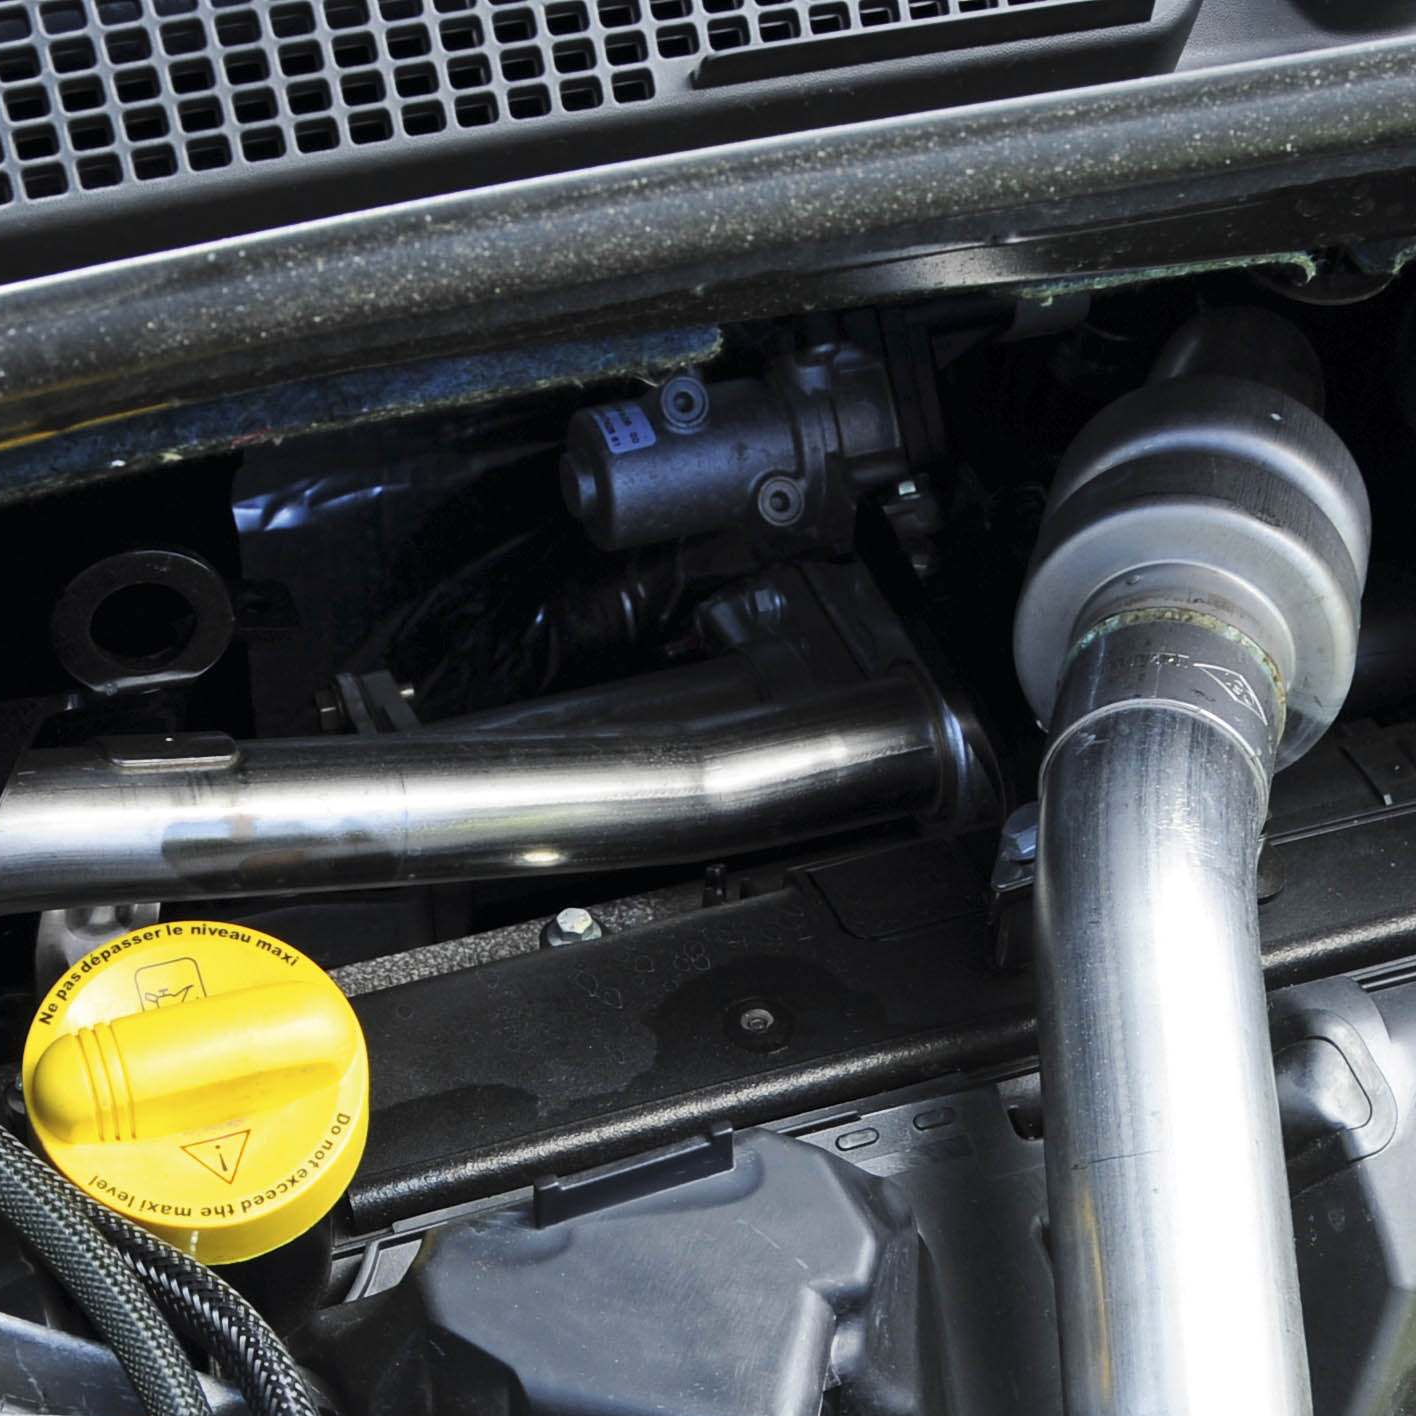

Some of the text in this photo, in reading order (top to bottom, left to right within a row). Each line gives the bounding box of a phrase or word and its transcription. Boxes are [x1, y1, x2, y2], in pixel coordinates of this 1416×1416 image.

[38, 924, 301, 1026] Ne pas dépasser le niveau maxi
[88, 1111, 351, 1218] Do not exceed the maxi level
